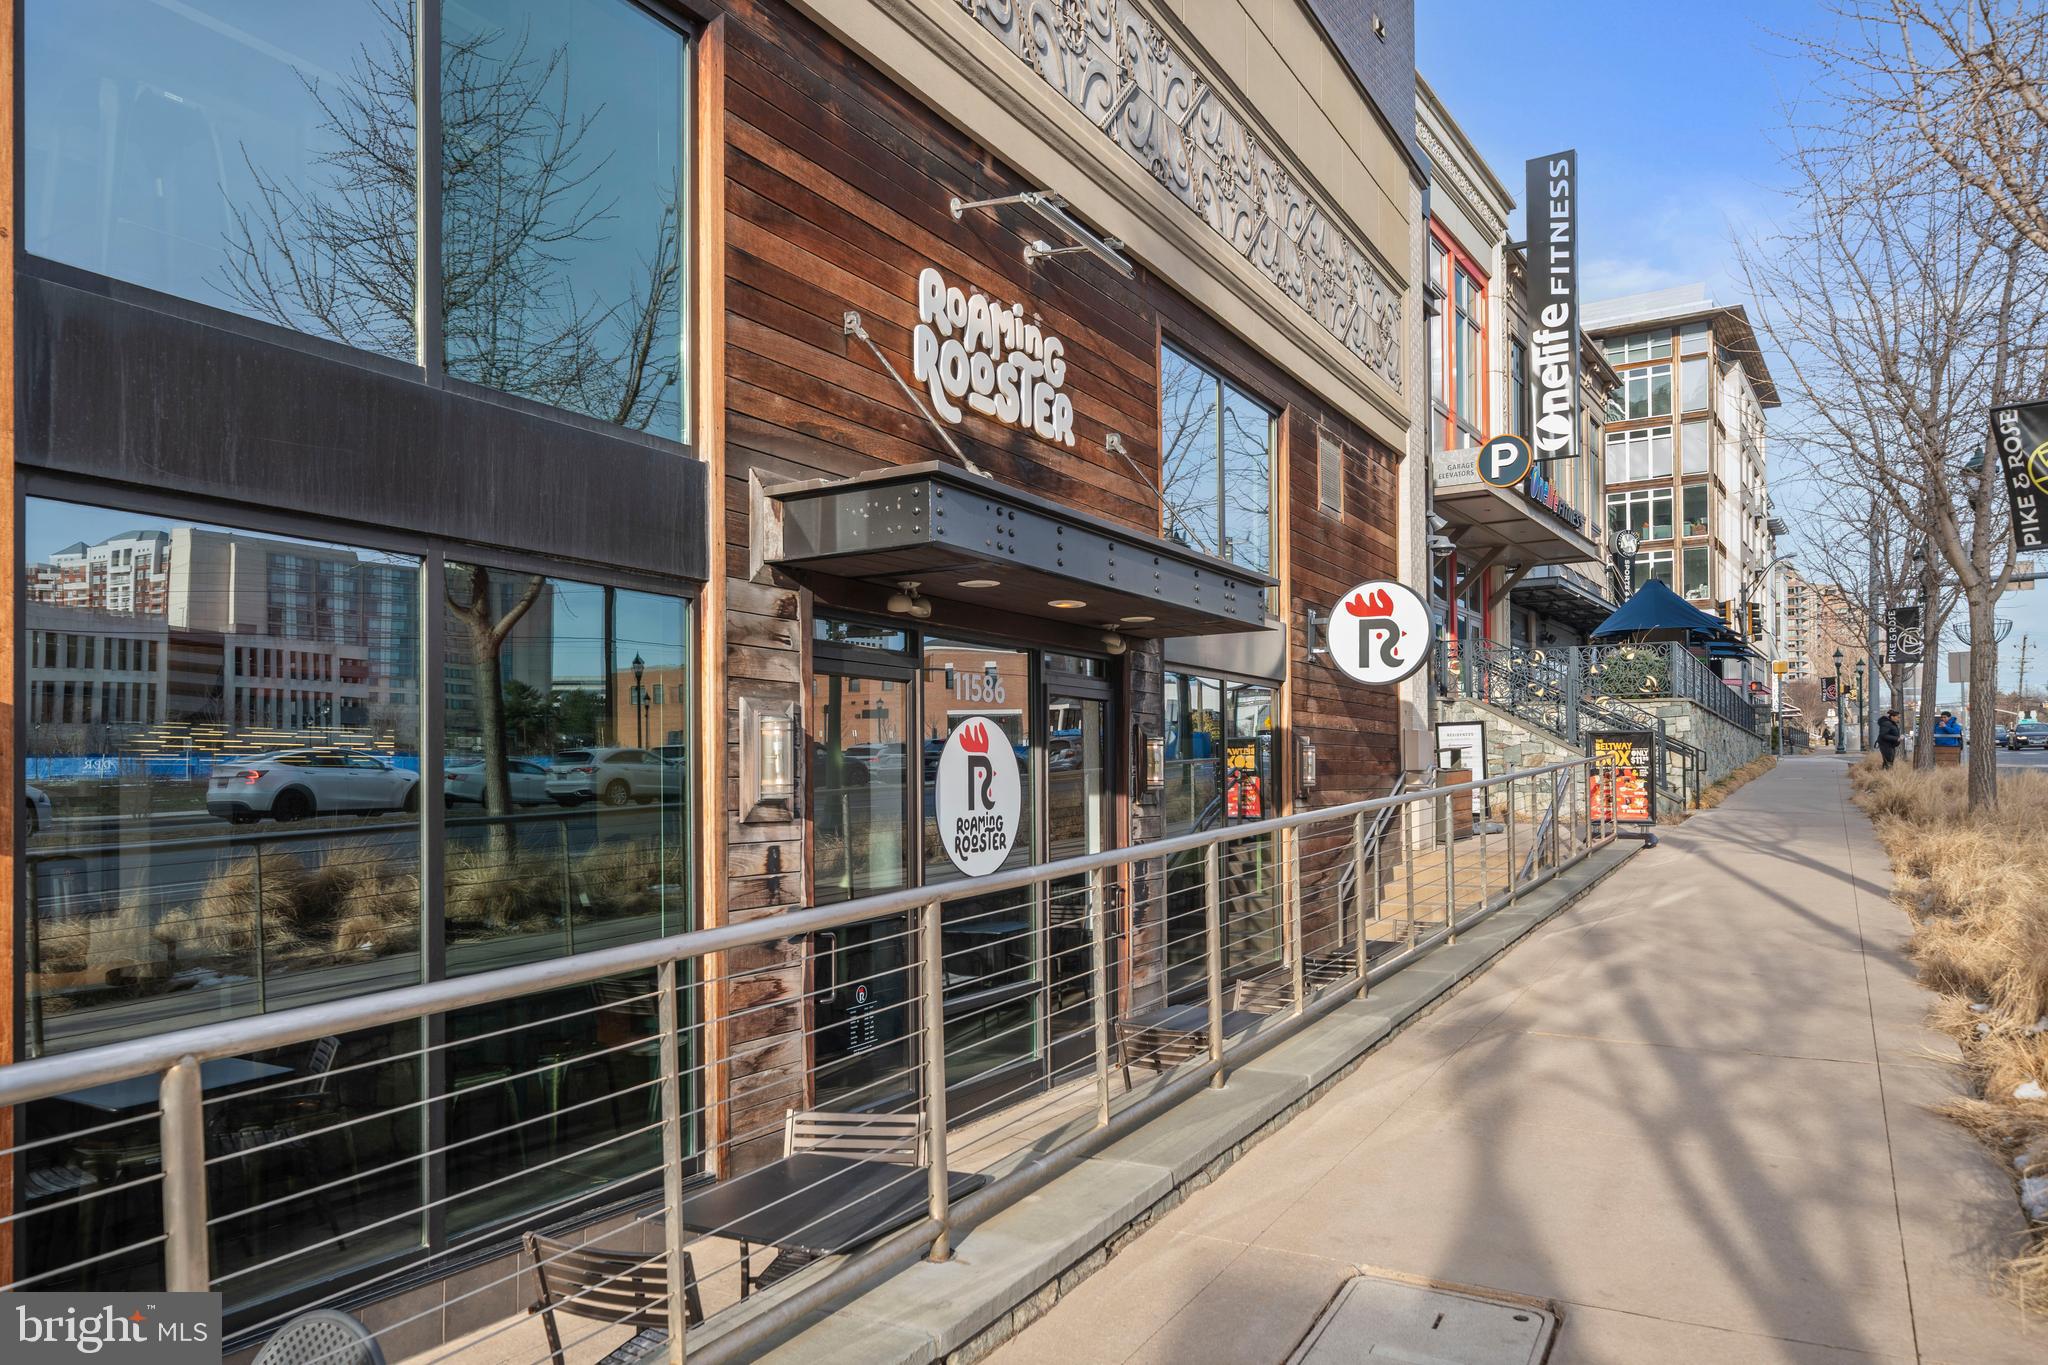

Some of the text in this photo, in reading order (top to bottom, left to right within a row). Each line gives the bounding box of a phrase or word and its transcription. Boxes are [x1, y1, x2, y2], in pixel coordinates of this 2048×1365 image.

[1550, 159, 1569, 295] FITNESS
[914, 324, 1075, 447] ROOSTER
[1999, 409, 2024, 469] ROSE
[1438, 470, 1475, 480] ELEVATORS
[1447, 462, 1474, 471] GARAGE
[1491, 443, 1518, 479] P
[2017, 494, 2042, 546] PIKE
[1888, 610, 1896, 633] ROSE
[1889, 644, 1897, 663] PIKE
[954, 671, 1006, 704] 11586
[955, 827, 1007, 861] ROOSTER
